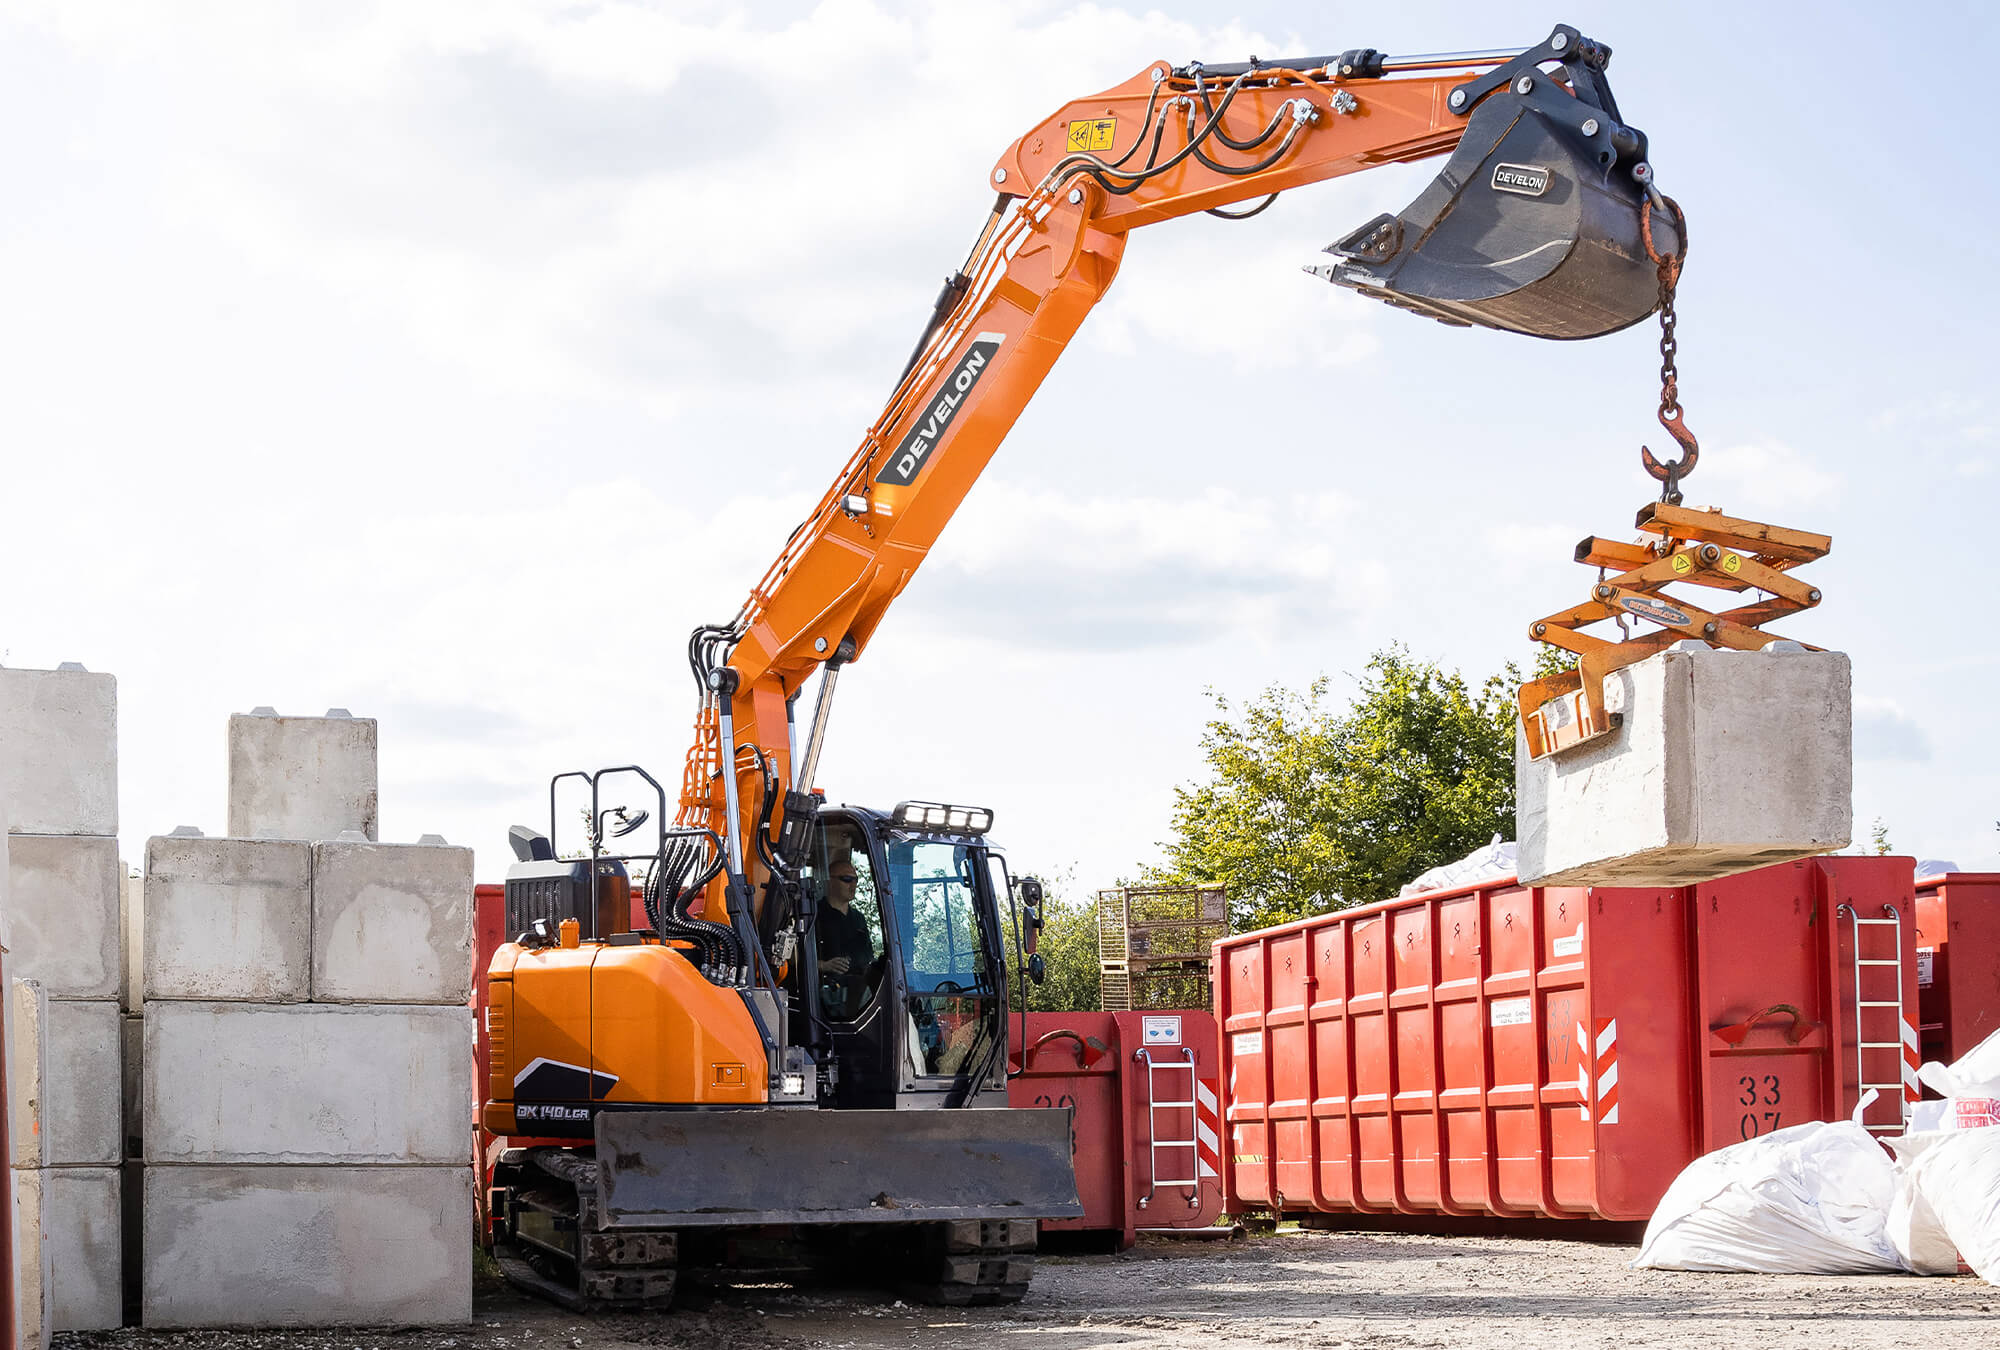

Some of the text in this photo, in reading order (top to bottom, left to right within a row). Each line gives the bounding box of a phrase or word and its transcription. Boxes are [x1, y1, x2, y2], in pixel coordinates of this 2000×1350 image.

[1497, 171, 1544, 189] DEVELON
[896, 350, 986, 479] DEVELON
[1740, 1075, 1781, 1106] 33
[1741, 1112, 1781, 1141] 07
